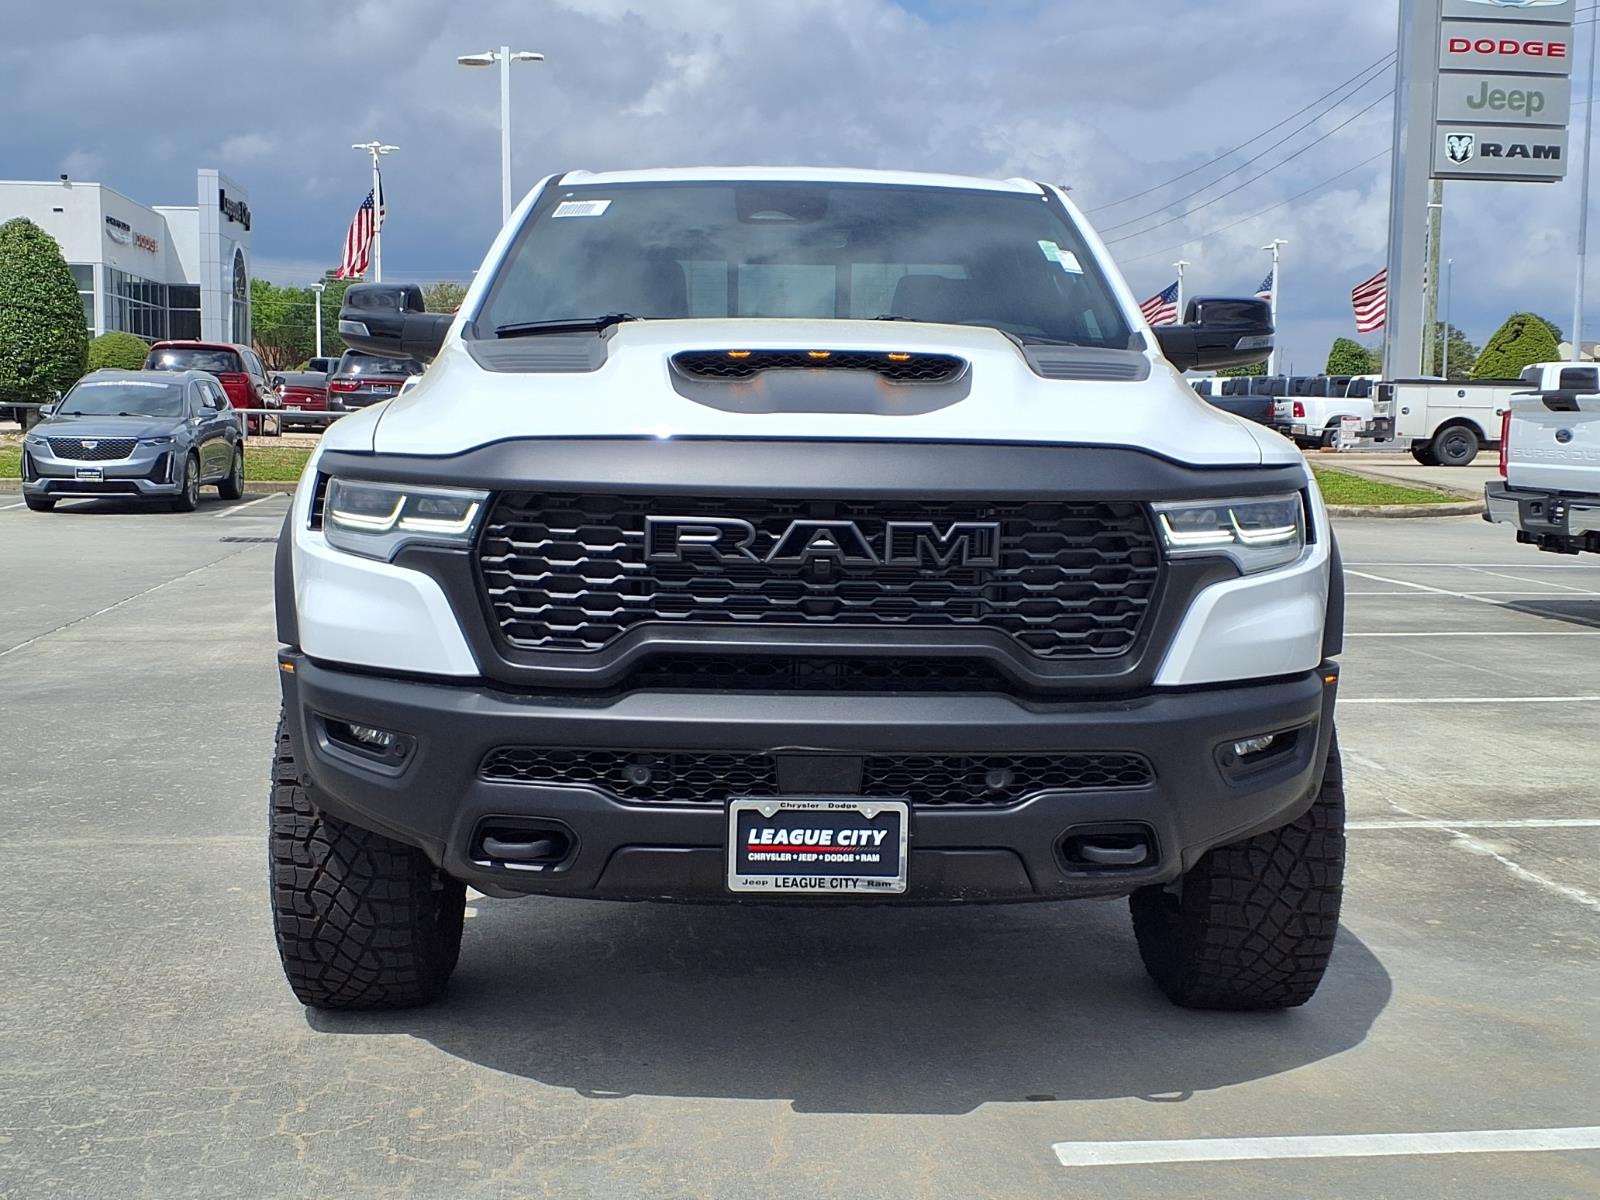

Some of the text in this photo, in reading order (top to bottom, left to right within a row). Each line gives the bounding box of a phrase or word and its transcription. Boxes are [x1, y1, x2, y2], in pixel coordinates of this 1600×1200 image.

[1449, 38, 1566, 58] DODGE
[1466, 80, 1545, 117] Jeep
[1480, 142, 1561, 160] RAM
[1512, 447, 1568, 460] SUPER
[644, 514, 1001, 567] RAM
[747, 828, 888, 846] LEAGUE CITY
[747, 852, 880, 862] CHRYSLER JEEP DODGE RAM
[741, 877, 892, 889] Jeep LEAGUE CITY Ram
